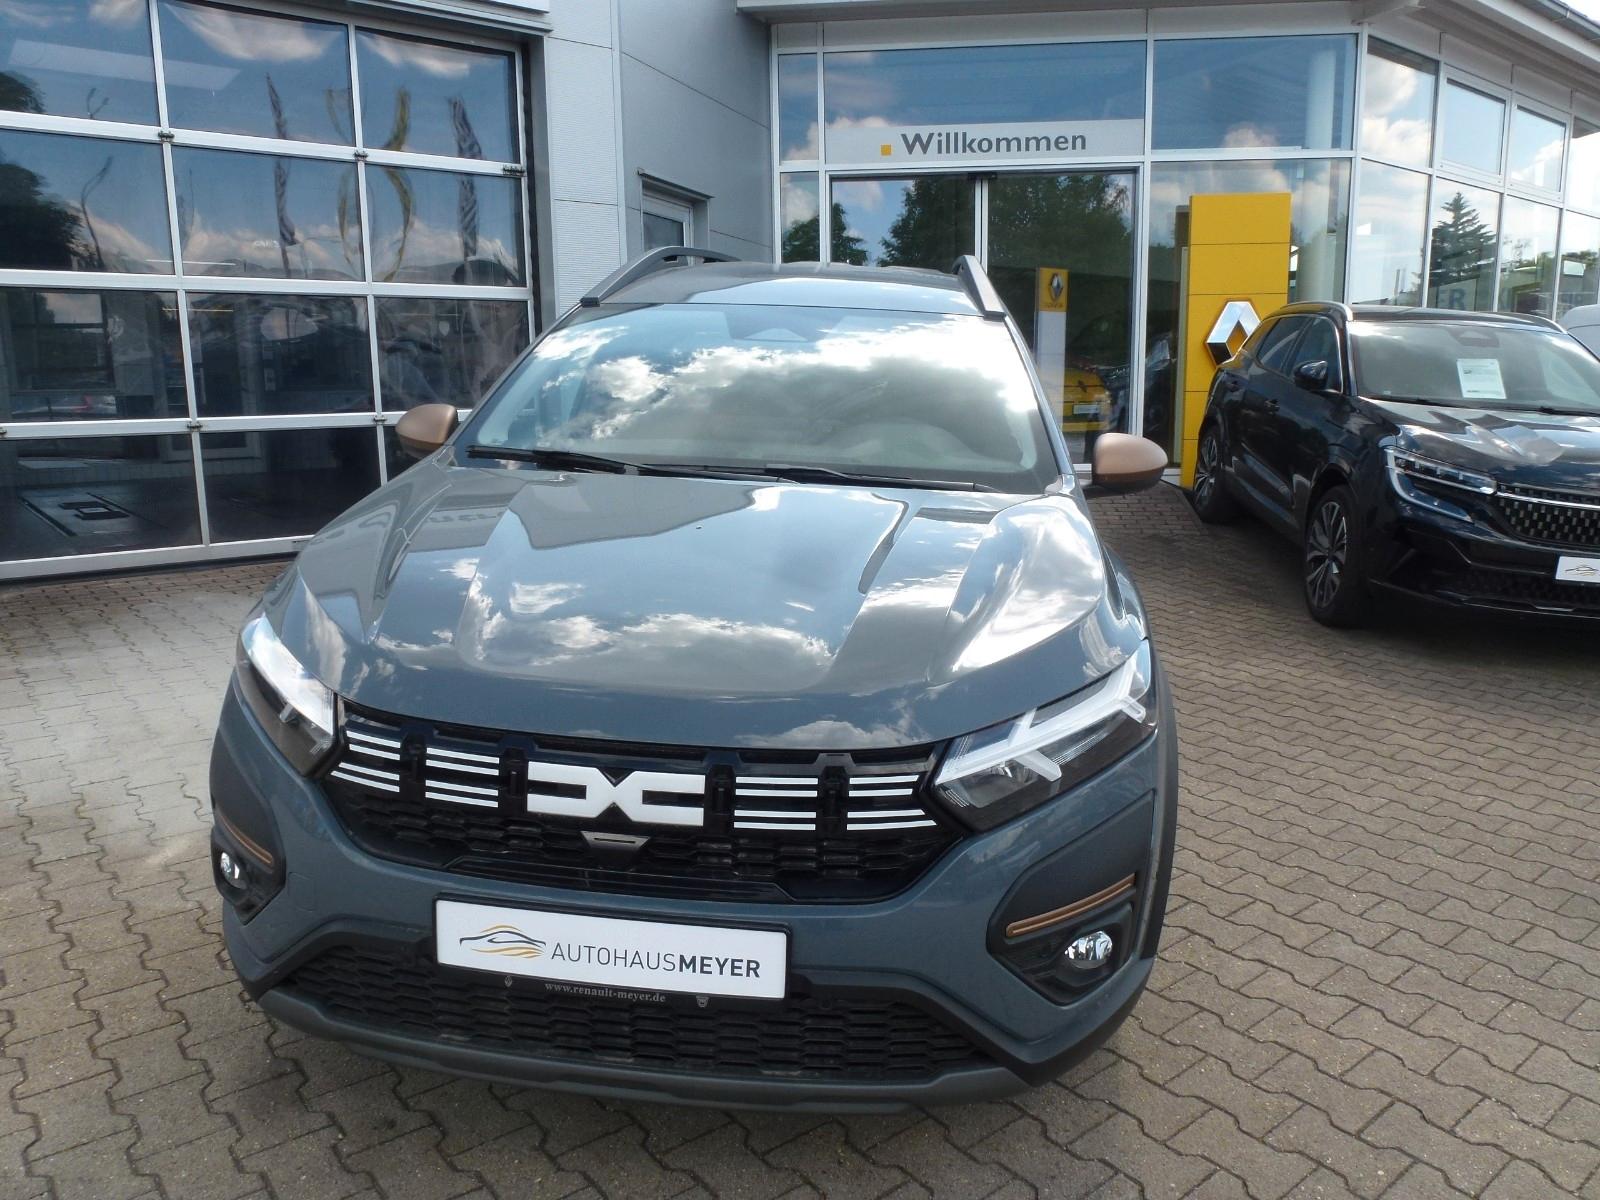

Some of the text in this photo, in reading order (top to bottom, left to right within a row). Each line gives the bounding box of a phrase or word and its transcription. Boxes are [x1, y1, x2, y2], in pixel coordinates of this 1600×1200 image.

[900, 131, 1087, 155] Willkommen
[551, 942, 761, 978] AUTOHAUSMEYER
[544, 983, 667, 1003] www.renault-meyer.de
